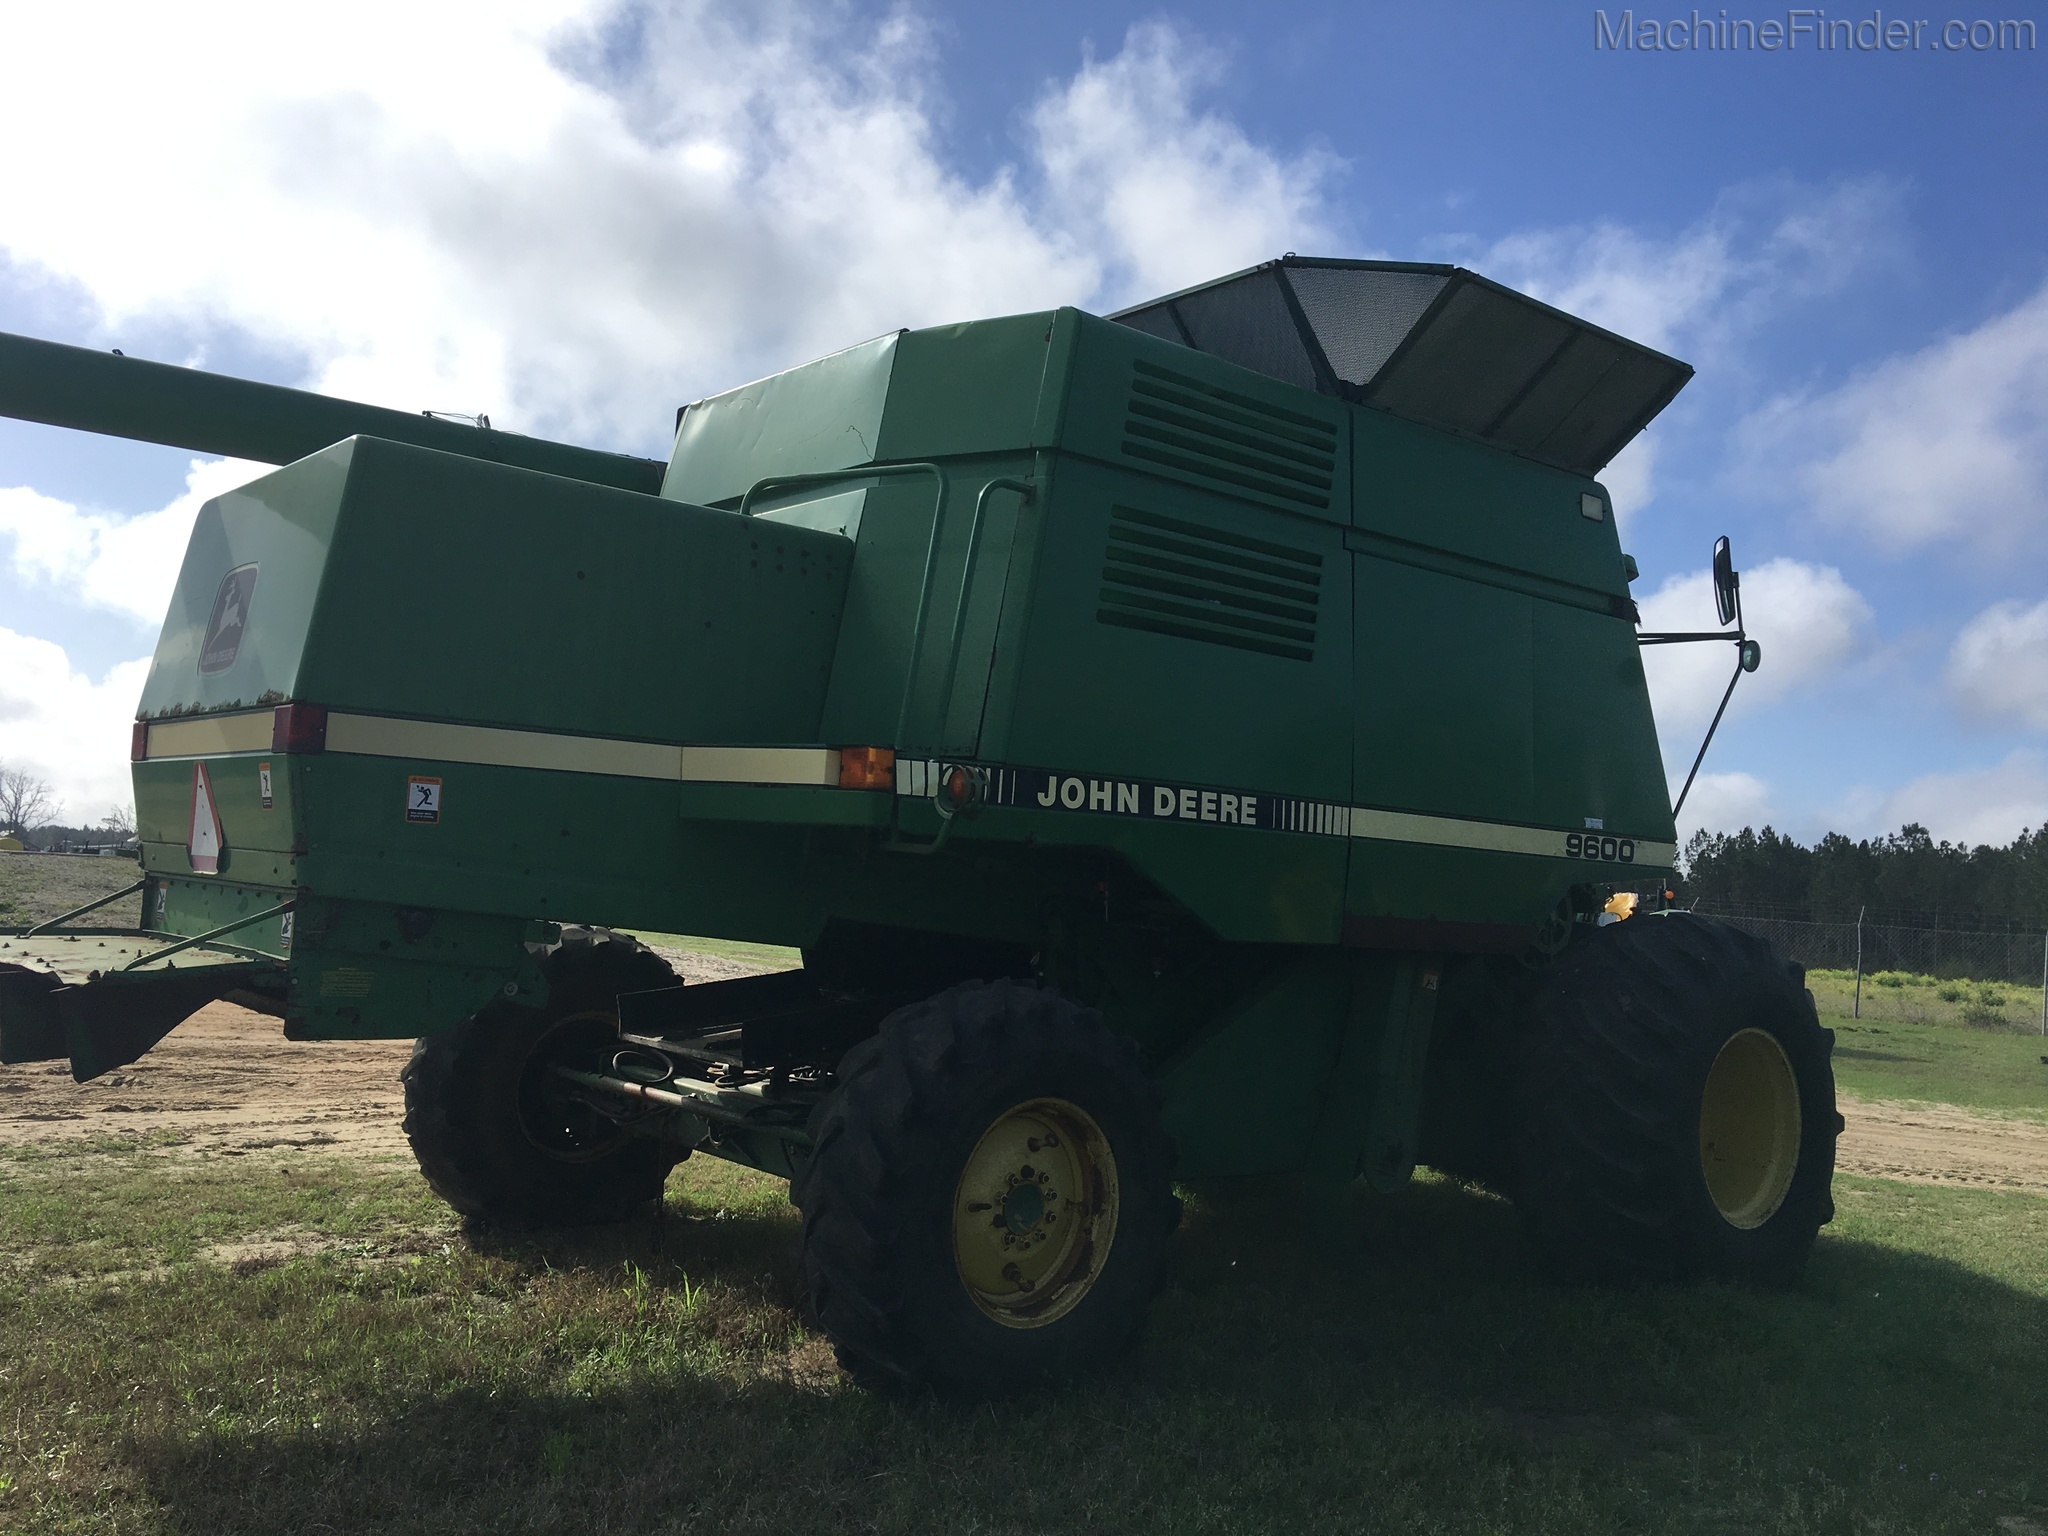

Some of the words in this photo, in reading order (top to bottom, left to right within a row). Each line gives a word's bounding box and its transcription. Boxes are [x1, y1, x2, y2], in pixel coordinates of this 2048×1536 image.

[1037, 775, 1139, 814] JOHN
[1153, 786, 1257, 825] DEERE
[1566, 833, 1635, 862] 9600
